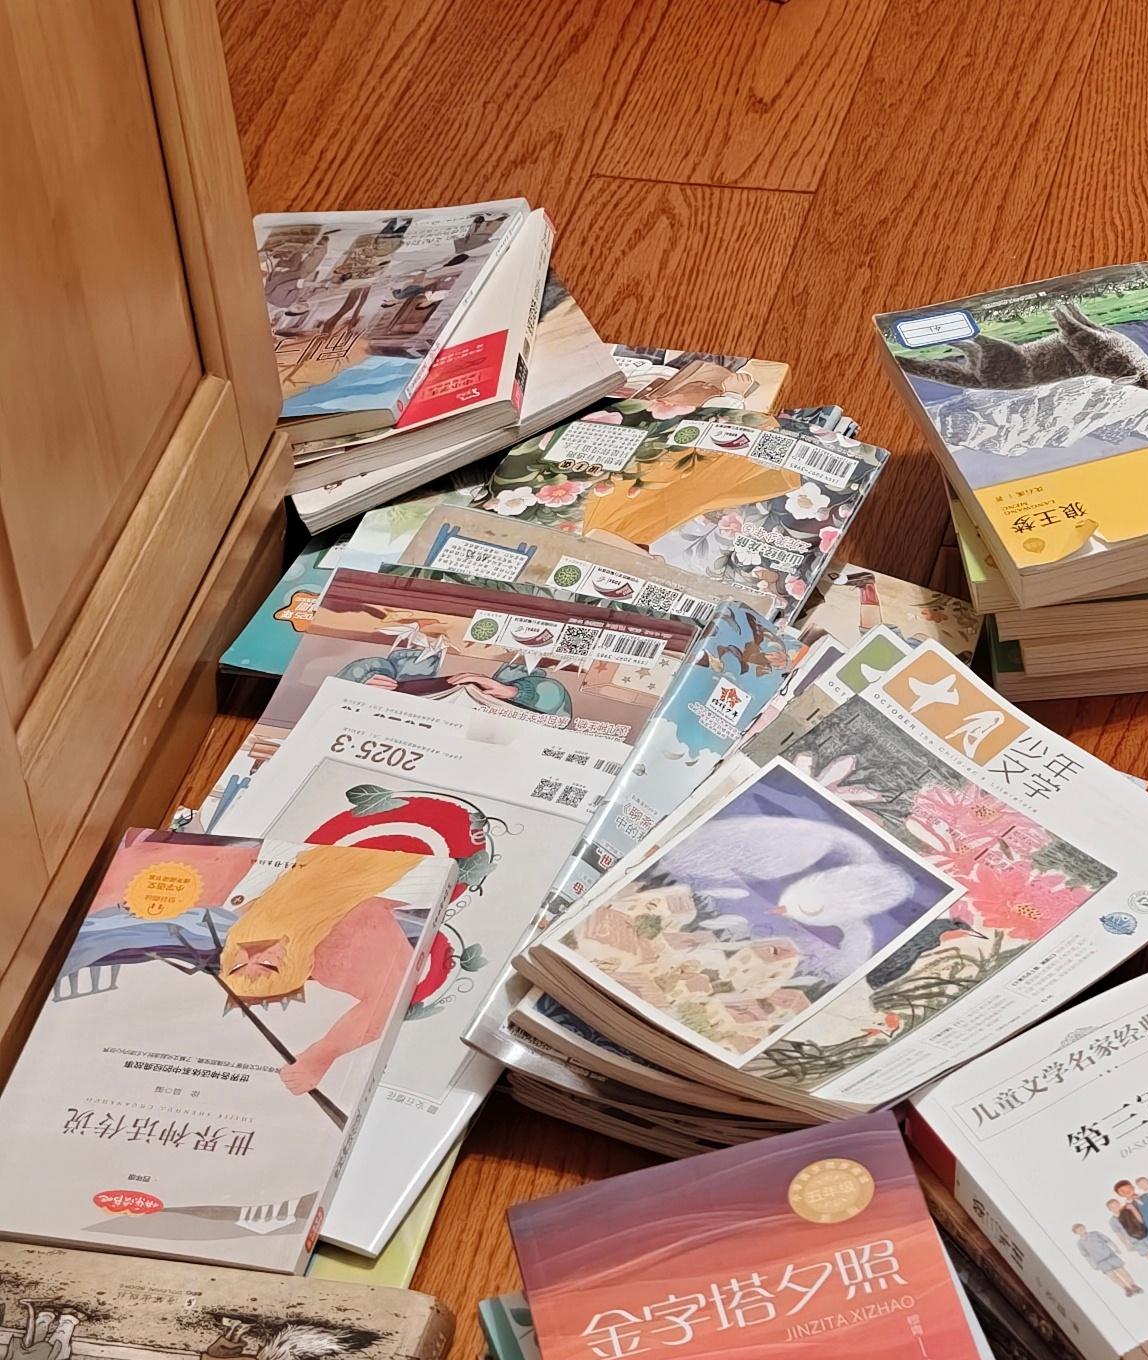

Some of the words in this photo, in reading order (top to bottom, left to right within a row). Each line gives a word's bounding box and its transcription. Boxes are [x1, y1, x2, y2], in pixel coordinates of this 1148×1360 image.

[1009, 500, 1091, 535] 狼王梦
[872, 693, 917, 731] OCTOBER
[329, 733, 425, 772] 2025·3
[1010, 736, 1087, 783] 少年
[987, 753, 1062, 800] 文学
[62, 1106, 256, 1158] 世界神话传说
[784, 1309, 849, 1343] JINZITA
[850, 1294, 915, 1324] XIZHAO
